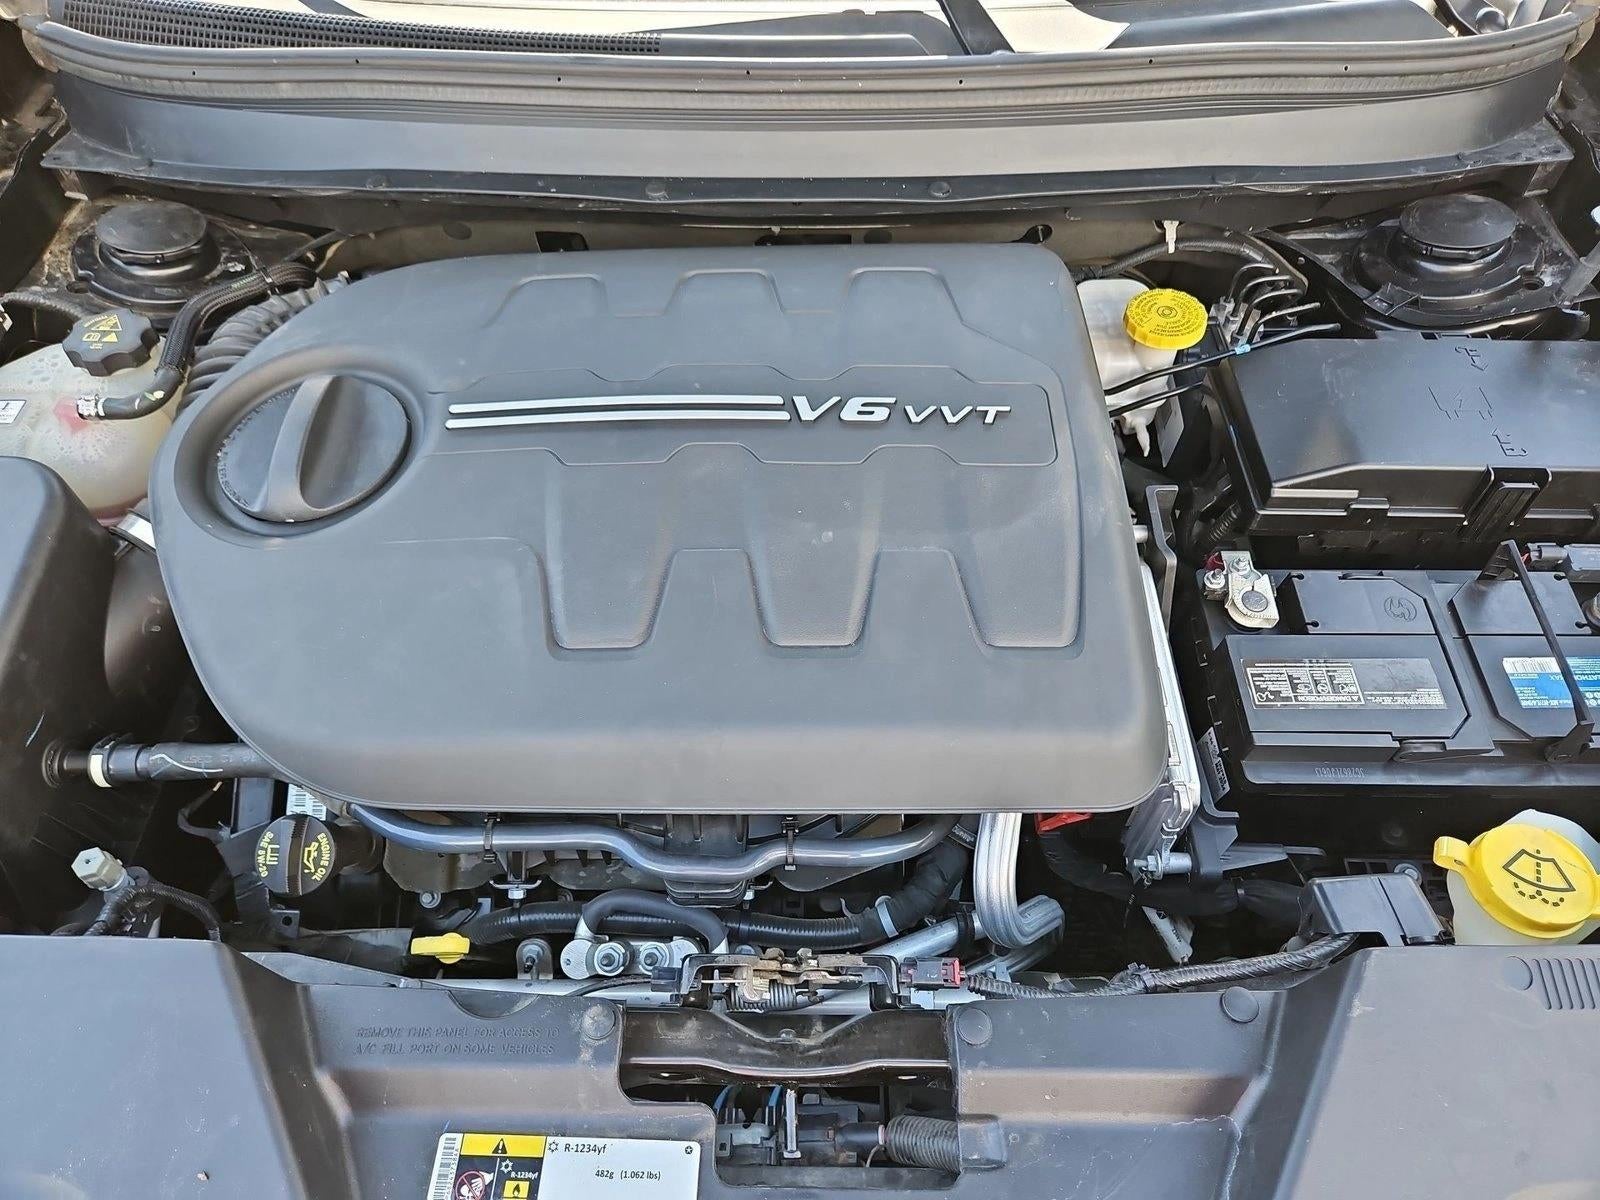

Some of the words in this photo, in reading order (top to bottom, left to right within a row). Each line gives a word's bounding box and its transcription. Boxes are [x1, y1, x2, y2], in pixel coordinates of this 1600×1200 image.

[792, 395, 897, 422] V6
[904, 405, 1012, 425] VVT
[260, 831, 274, 848] SAE
[317, 832, 331, 867] ENGINE
[311, 867, 326, 882] OIL
[355, 1026, 403, 1038] REMOVE
[407, 1027, 432, 1038] THIS
[434, 1027, 469, 1038] PANEL
[473, 1027, 497, 1038] FOR
[499, 1027, 542, 1039] ACCESS
[545, 1027, 561, 1039] TO
[354, 1043, 378, 1055] A/C
[381, 1043, 404, 1055] FILL
[409, 1043, 440, 1055] PORT
[443, 1043, 463, 1055] ON
[464, 1043, 495, 1054] SOME
[501, 1043, 555, 1055] VEHICLES
[563, 1144, 607, 1156] R-1234yf
[510, 1171, 539, 1180] R-1234yf
[595, 1169, 614, 1179] 482g
[620, 1169, 645, 1180] (1.062
[646, 1170, 662, 1181] lbs)
